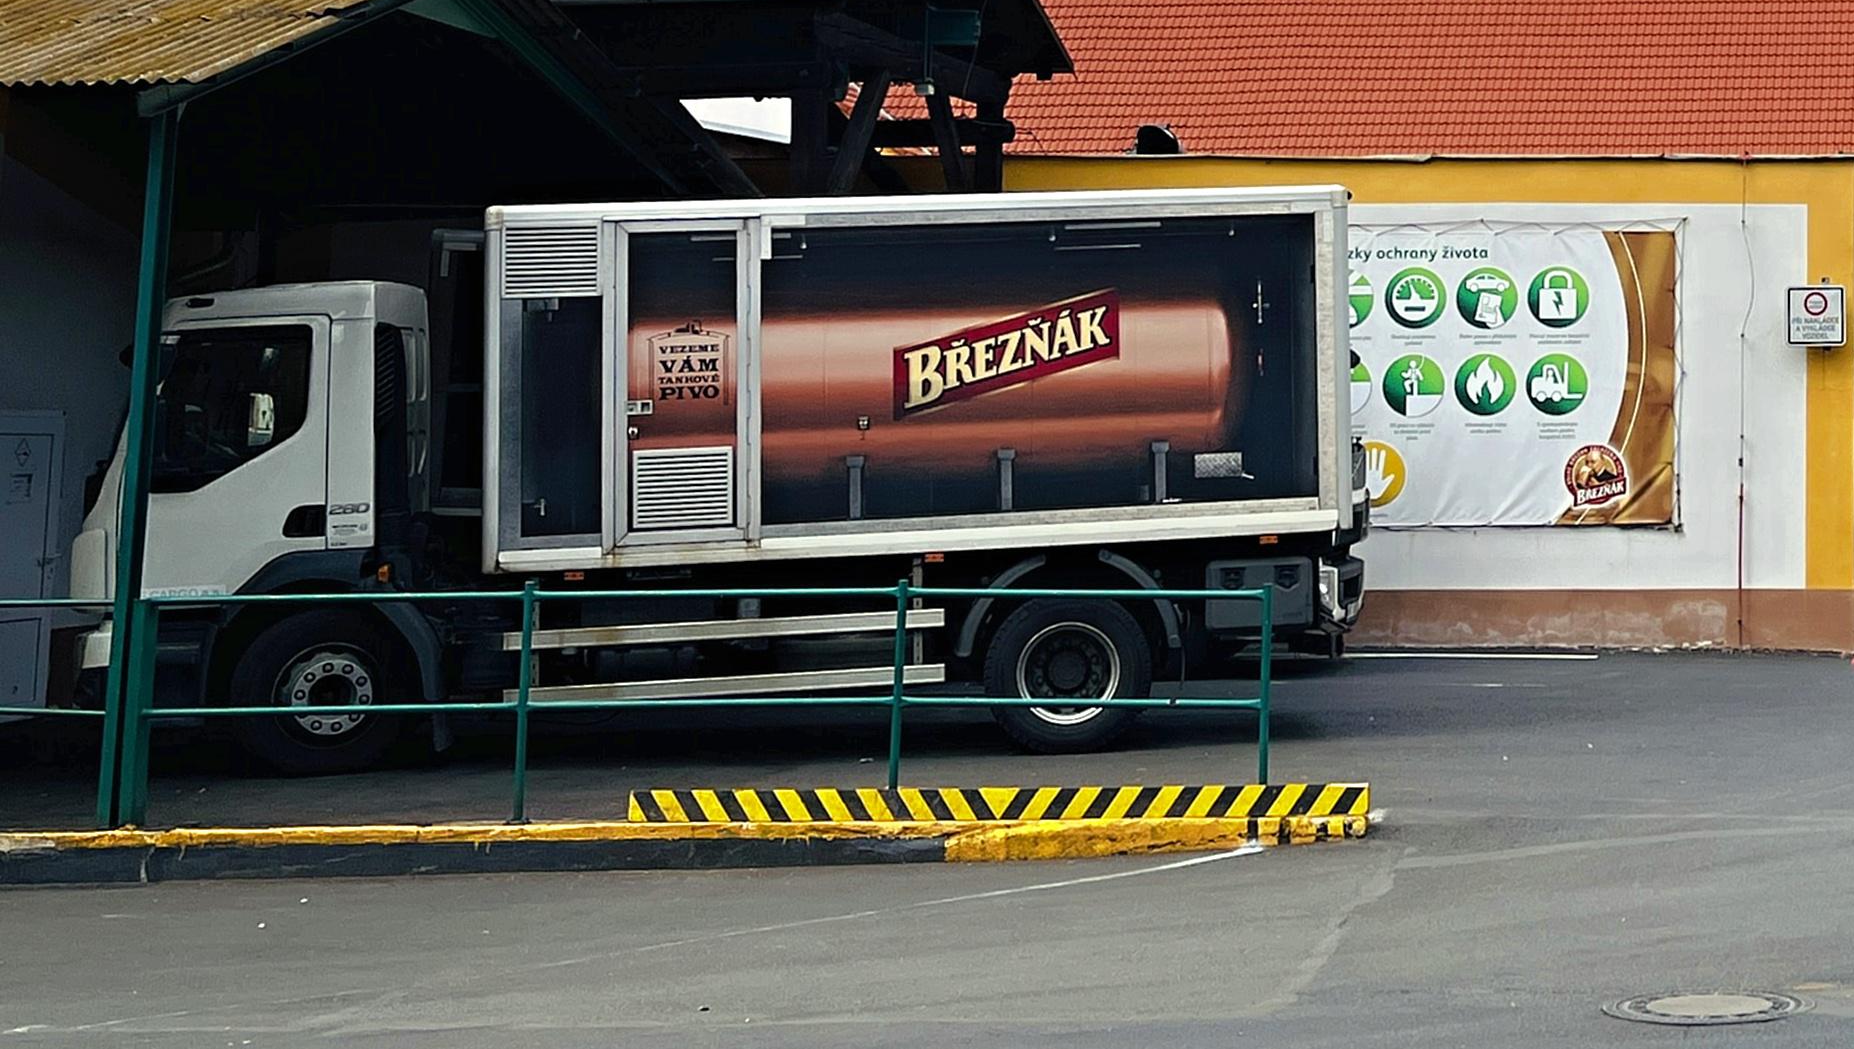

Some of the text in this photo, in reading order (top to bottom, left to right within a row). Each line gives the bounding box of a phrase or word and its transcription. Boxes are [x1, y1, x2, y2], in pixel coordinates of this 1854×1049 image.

[1376, 246, 1437, 263] ochrany
[1442, 245, 1489, 259] života
[659, 344, 719, 354] VEZEME
[659, 355, 719, 373] VÁM
[904, 306, 1110, 409] BŘEZŇÁK
[658, 374, 720, 384] TANKOVÉ
[659, 385, 720, 400] PIVO
